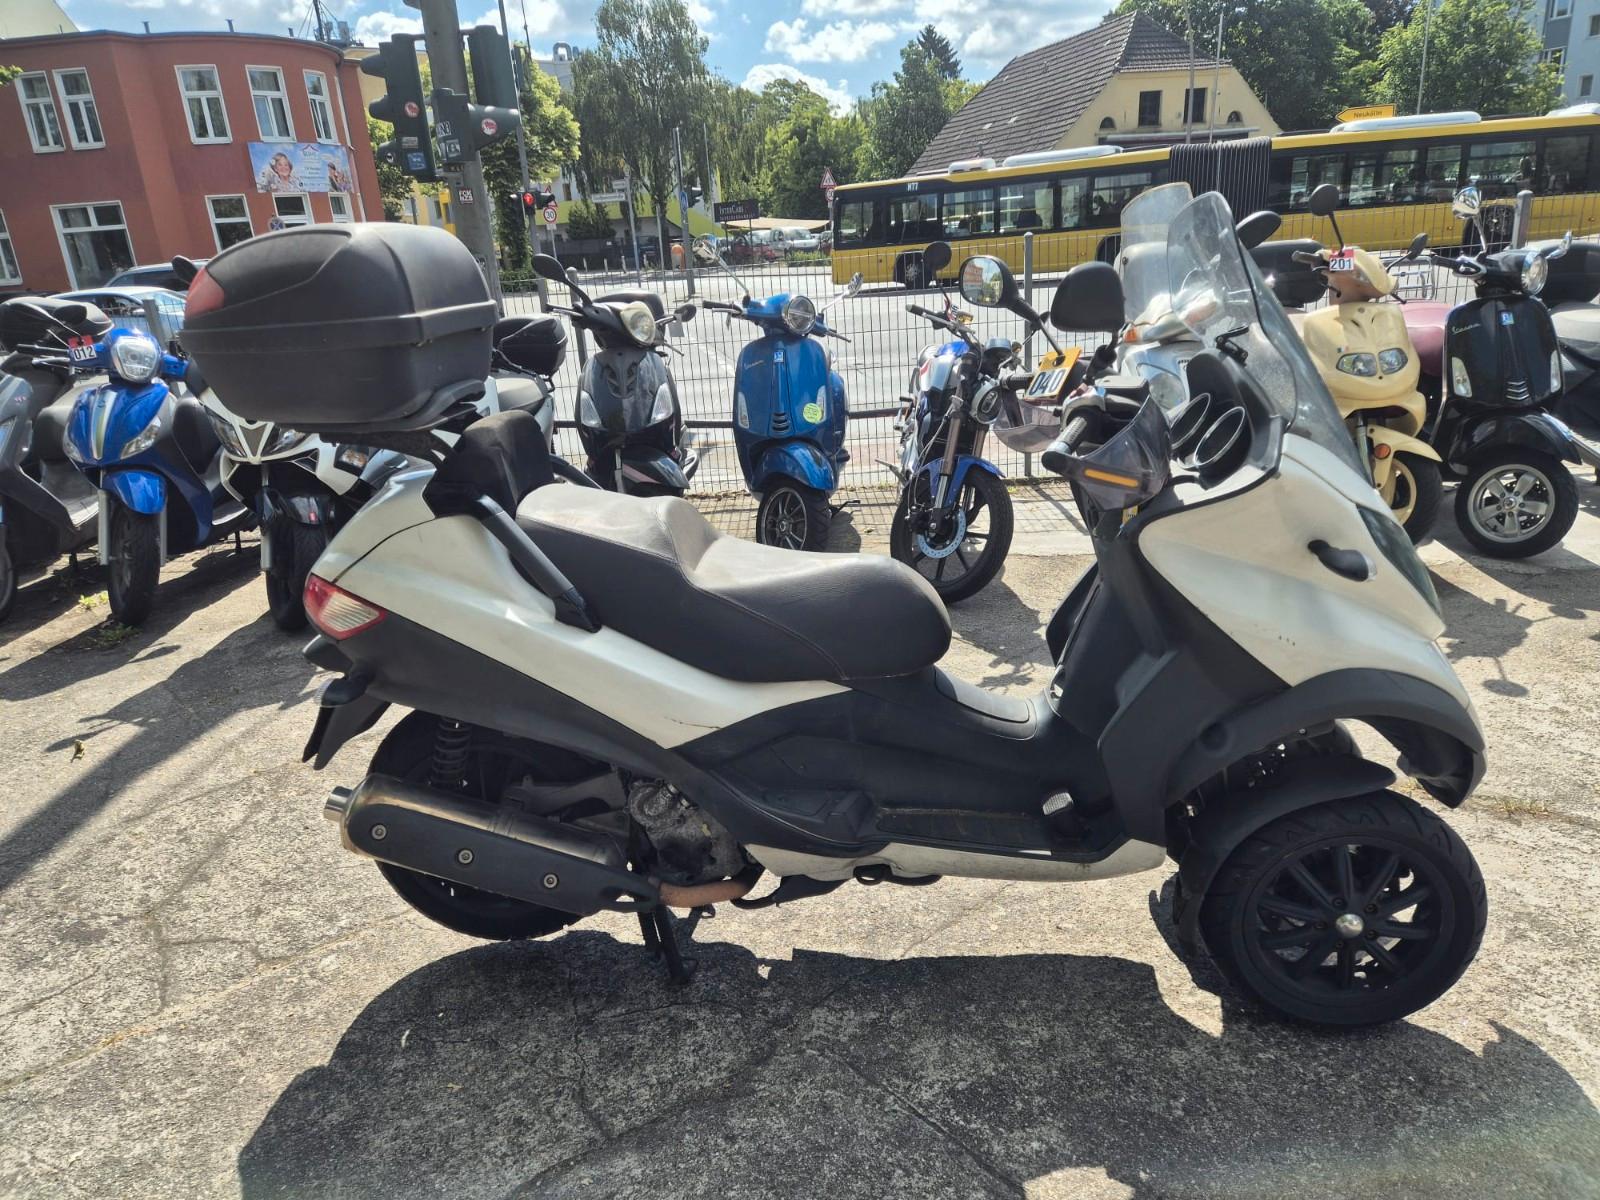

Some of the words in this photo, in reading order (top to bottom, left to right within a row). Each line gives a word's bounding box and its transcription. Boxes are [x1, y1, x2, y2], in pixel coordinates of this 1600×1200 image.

[545, 209, 555, 219] 30
[1331, 258, 1352, 270] 201
[73, 346, 96, 360] 012
[1028, 368, 1066, 396] 040
